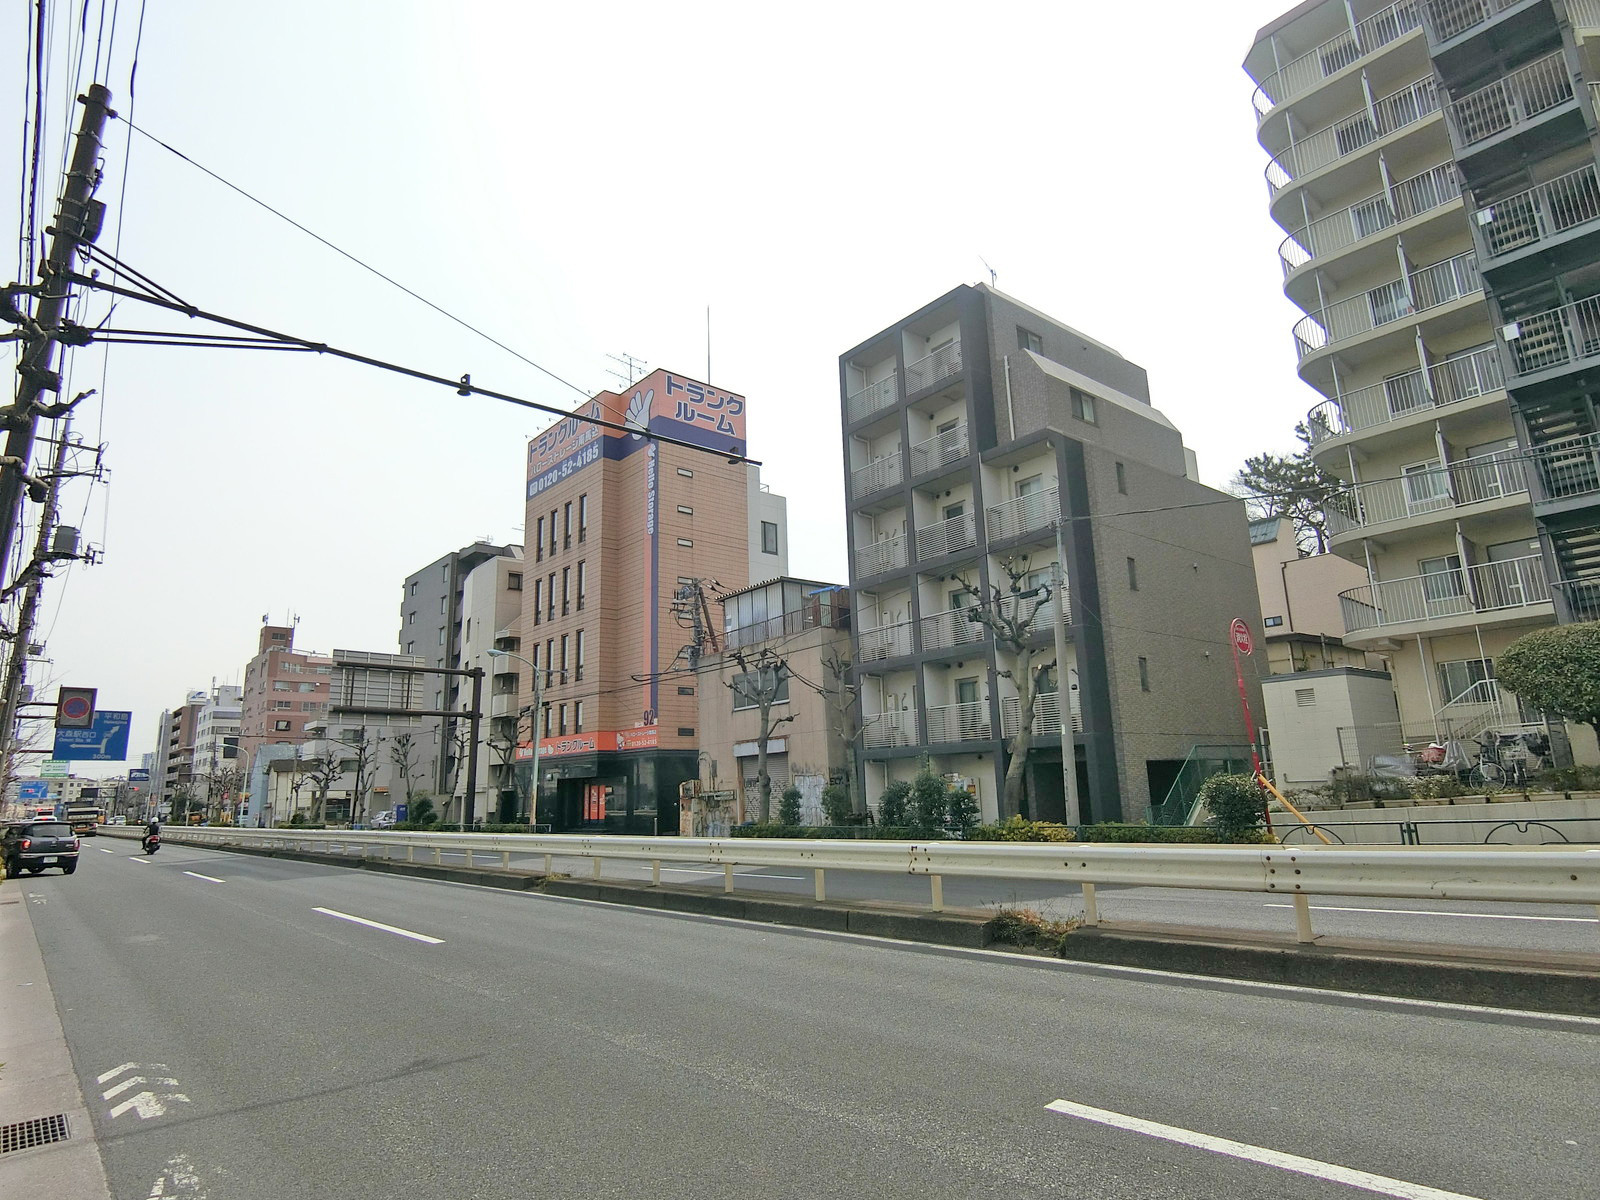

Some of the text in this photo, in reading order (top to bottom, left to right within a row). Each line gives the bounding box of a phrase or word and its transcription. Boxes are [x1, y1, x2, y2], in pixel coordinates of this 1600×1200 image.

[666, 374, 744, 416] トランク
[675, 400, 737, 436] ルーム
[538, 444, 599, 490] 0120-52-4185
[647, 490, 655, 535] Storage
[643, 709, 654, 726] 92
[556, 737, 596, 752] トランクルーム
